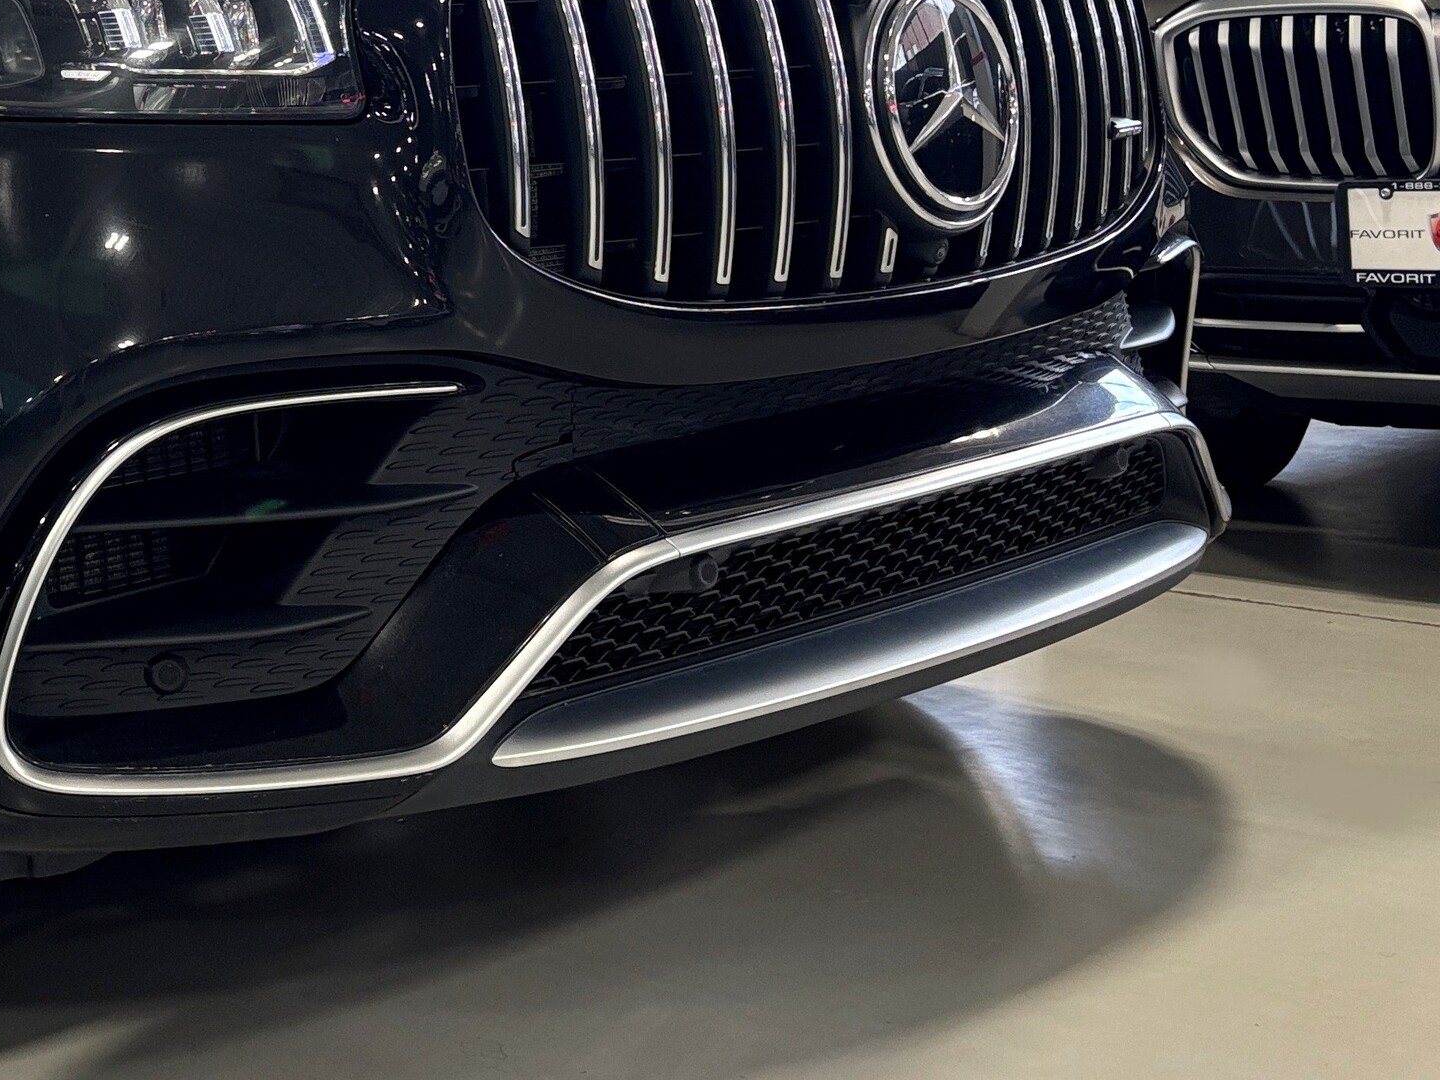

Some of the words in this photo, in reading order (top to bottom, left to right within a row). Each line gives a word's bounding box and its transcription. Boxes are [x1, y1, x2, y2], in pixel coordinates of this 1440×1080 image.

[1391, 181, 1440, 191] 1-888-
[1349, 229, 1426, 239] FAVORIT
[1355, 272, 1437, 284] FAVORIT
